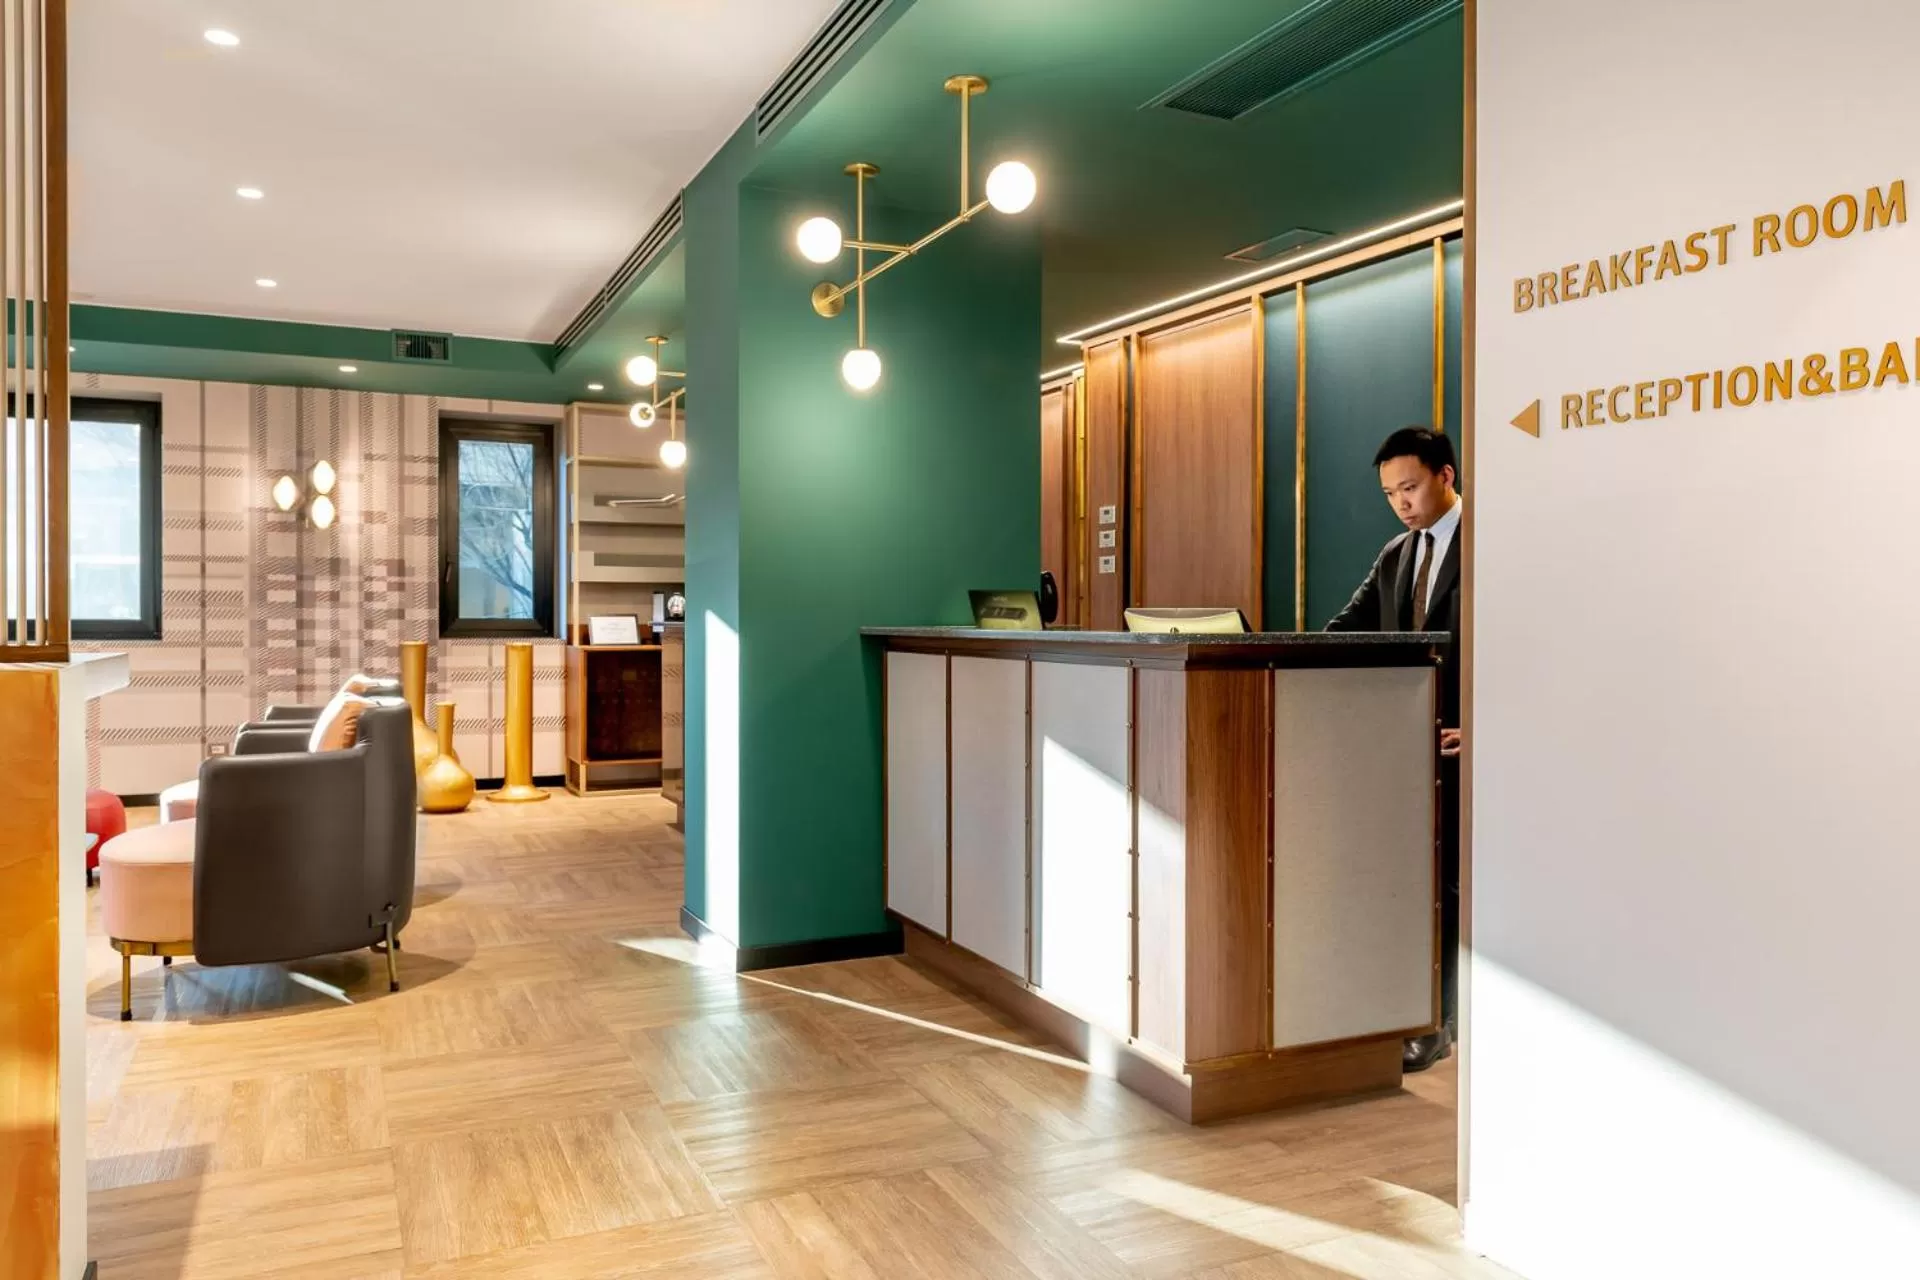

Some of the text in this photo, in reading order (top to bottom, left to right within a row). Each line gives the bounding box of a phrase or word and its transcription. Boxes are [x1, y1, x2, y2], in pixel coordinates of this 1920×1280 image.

[1514, 179, 1908, 313] BREAKFAST ROOM
[1560, 336, 1920, 429] RECEPTION&BA
